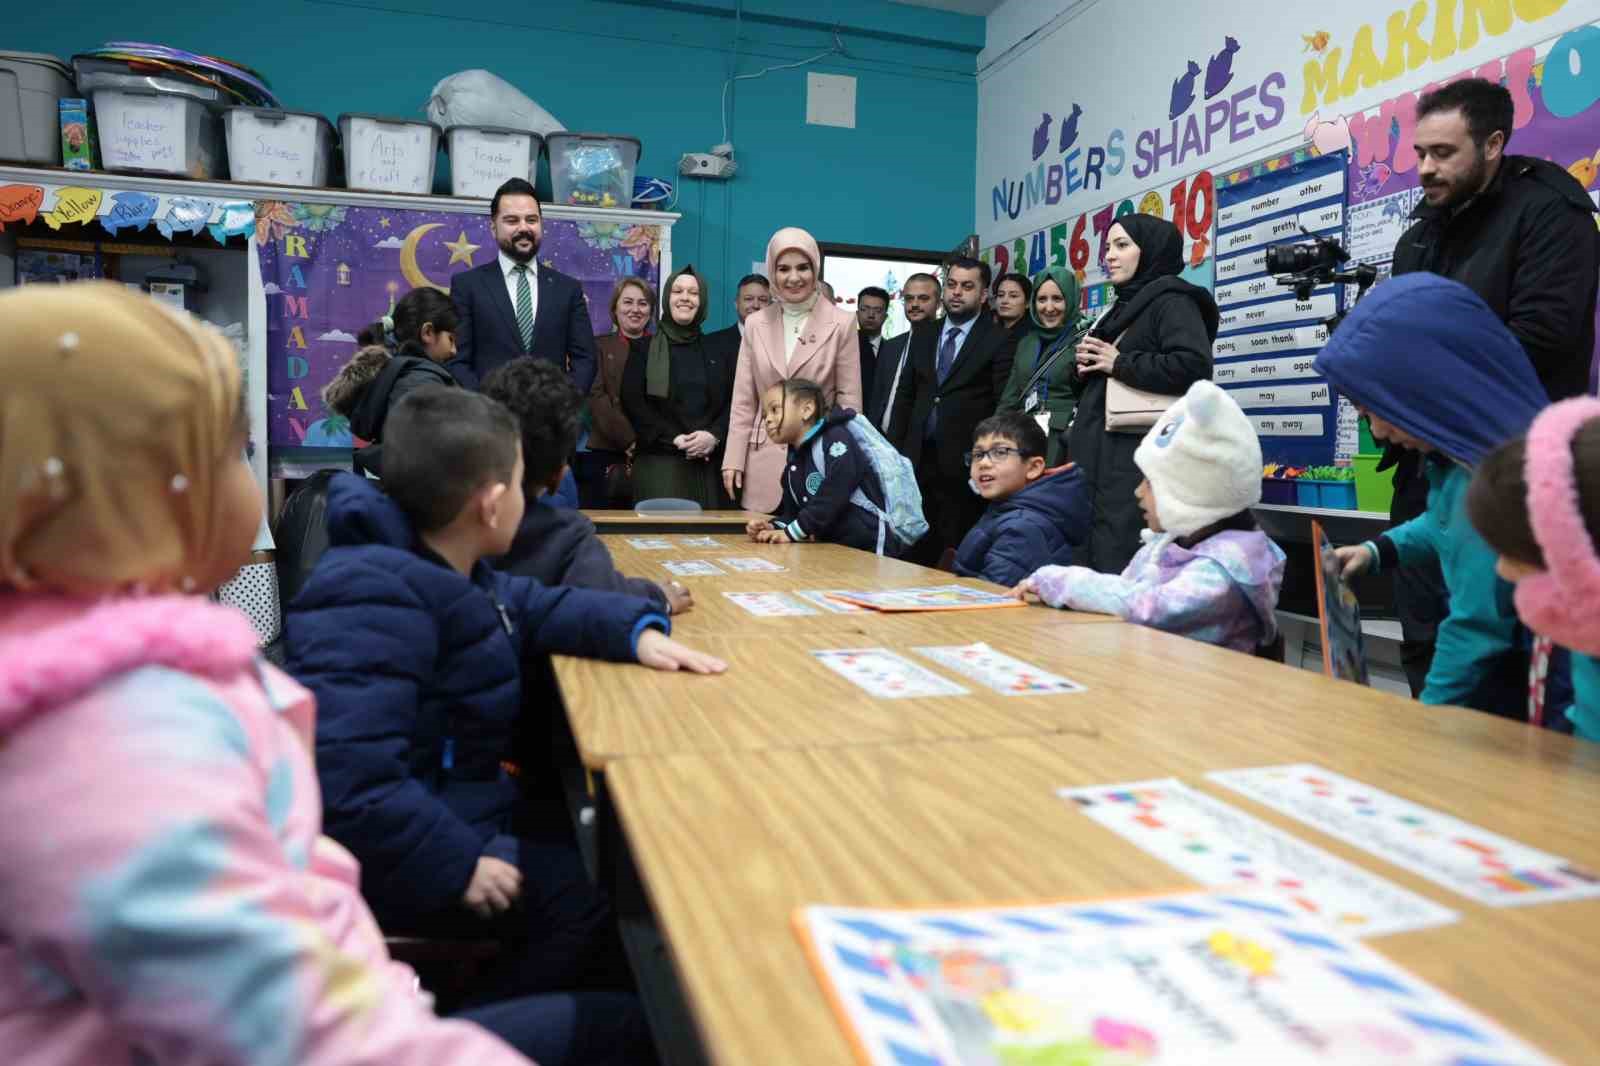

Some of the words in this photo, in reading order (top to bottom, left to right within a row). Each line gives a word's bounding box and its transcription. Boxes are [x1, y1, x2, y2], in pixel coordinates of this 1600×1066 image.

[1300, 0, 1568, 114] MAKIN
[992, 128, 1126, 222] NUMBERS
[1132, 72, 1286, 179] SHAPES
[56, 194, 97, 221] Yellow
[1251, 197, 1280, 211] number
[1299, 184, 1322, 196] other
[1069, 213, 1089, 272] 6
[1230, 233, 1252, 247] please
[1272, 221, 1296, 235] pretty
[1320, 211, 1338, 224] very
[1248, 283, 1266, 294] right
[1246, 311, 1265, 320] never
[1295, 303, 1312, 312] how
[284, 235, 309, 442] RAMADAN
[1216, 341, 1236, 352] going
[1250, 338, 1269, 347] soon
[1271, 333, 1294, 343] thank
[1217, 368, 1235, 378] carry
[1250, 364, 1276, 375] always
[1259, 392, 1275, 401] may
[1311, 388, 1327, 400] pull
[1260, 421, 1275, 431] any
[1282, 421, 1303, 431] away
